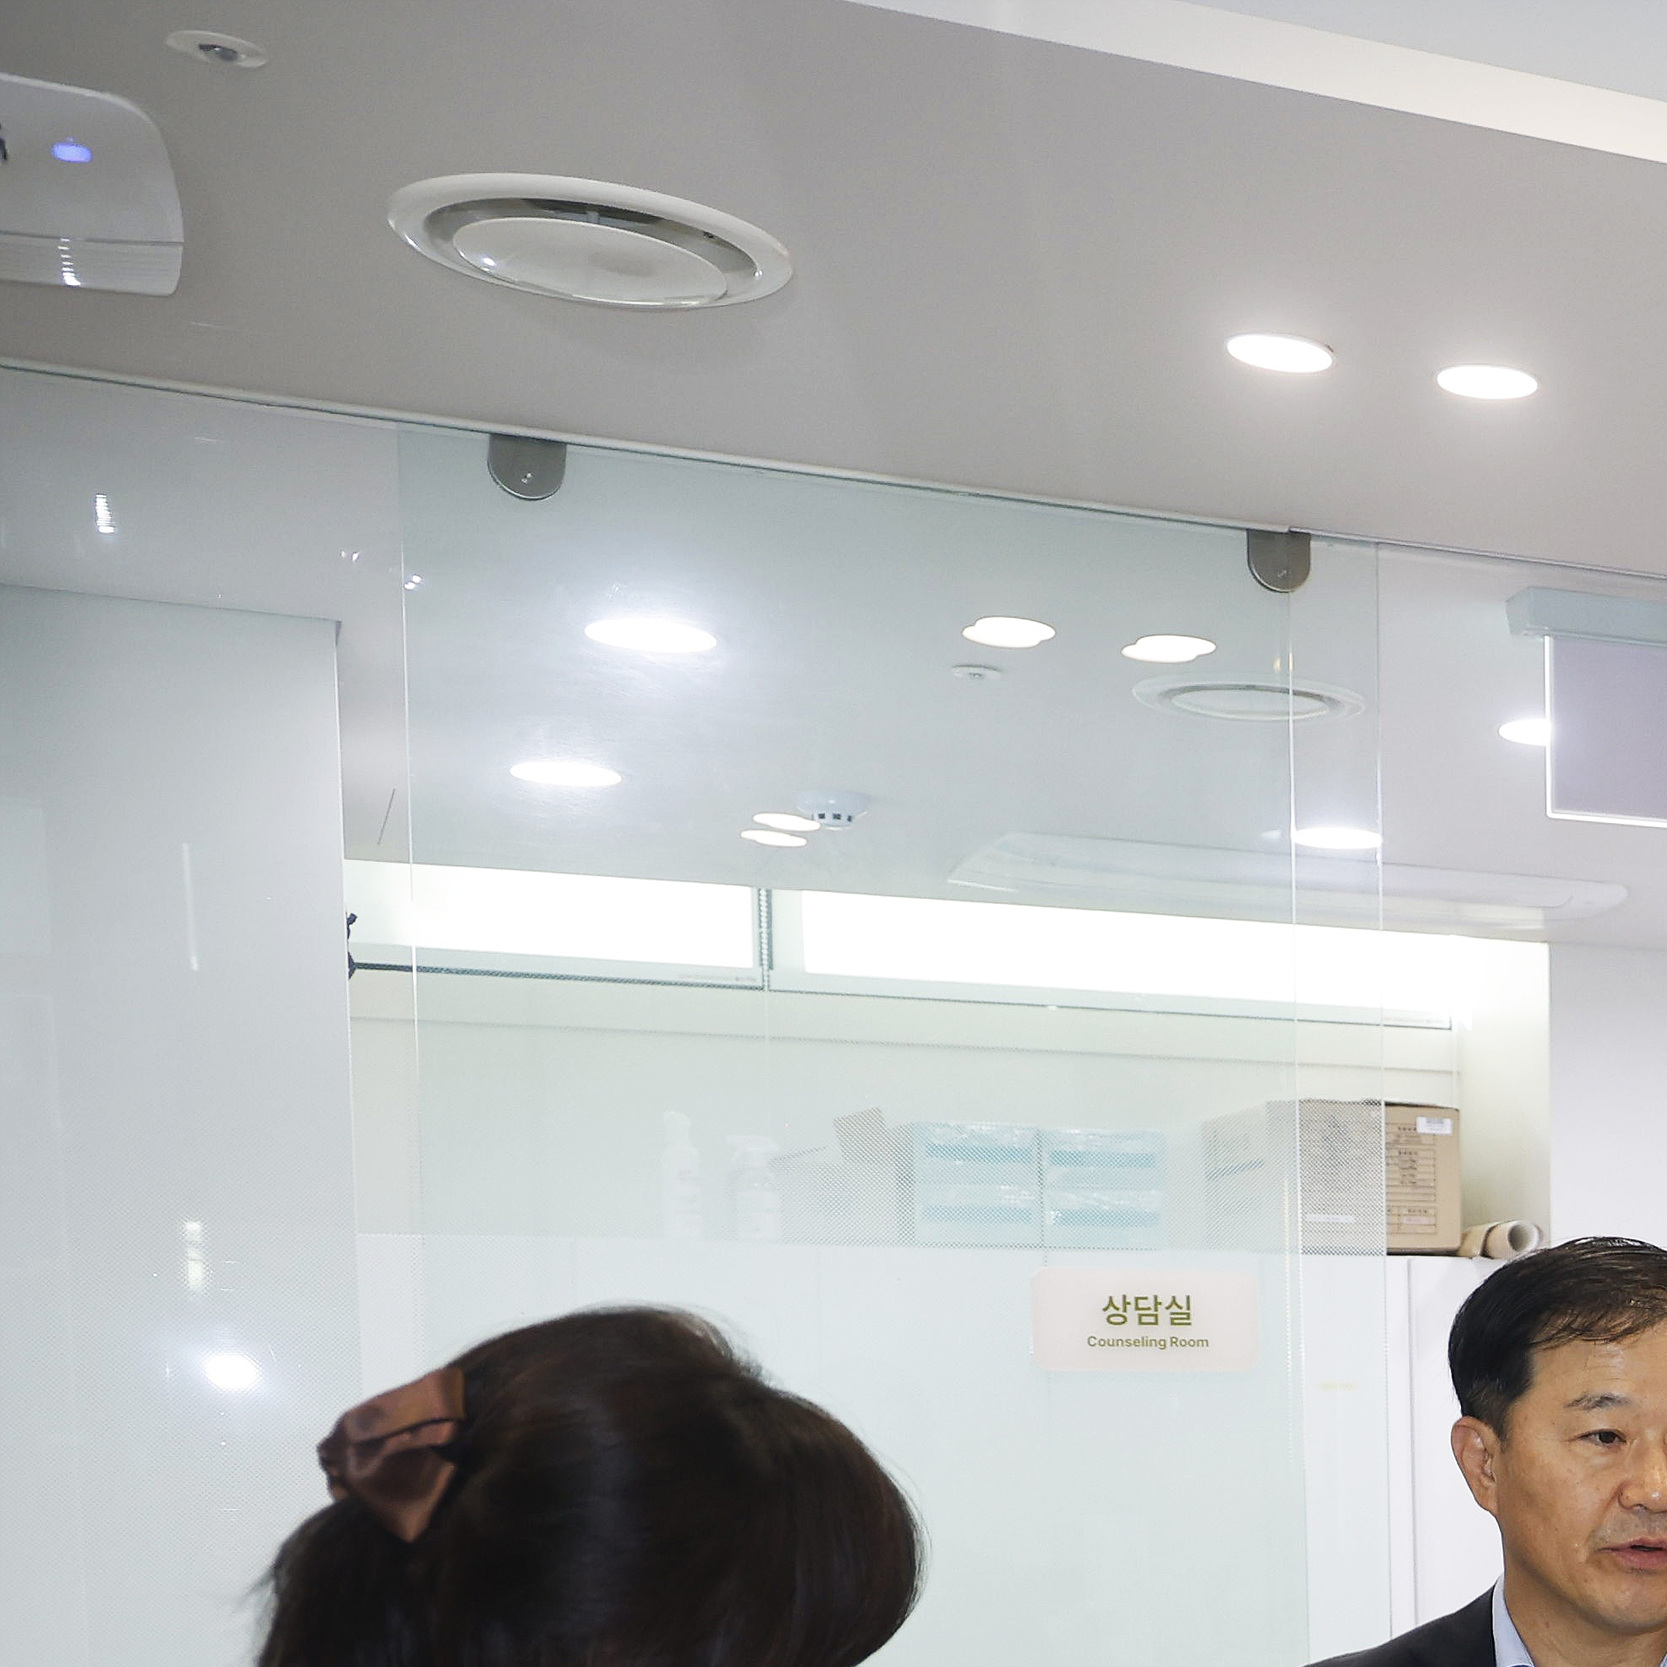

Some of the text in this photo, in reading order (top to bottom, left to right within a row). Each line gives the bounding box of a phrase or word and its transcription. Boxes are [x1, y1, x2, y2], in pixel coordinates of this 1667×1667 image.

[1102, 1294, 1193, 1326] 상담실
[1087, 1335, 1209, 1350] Counseling Room
